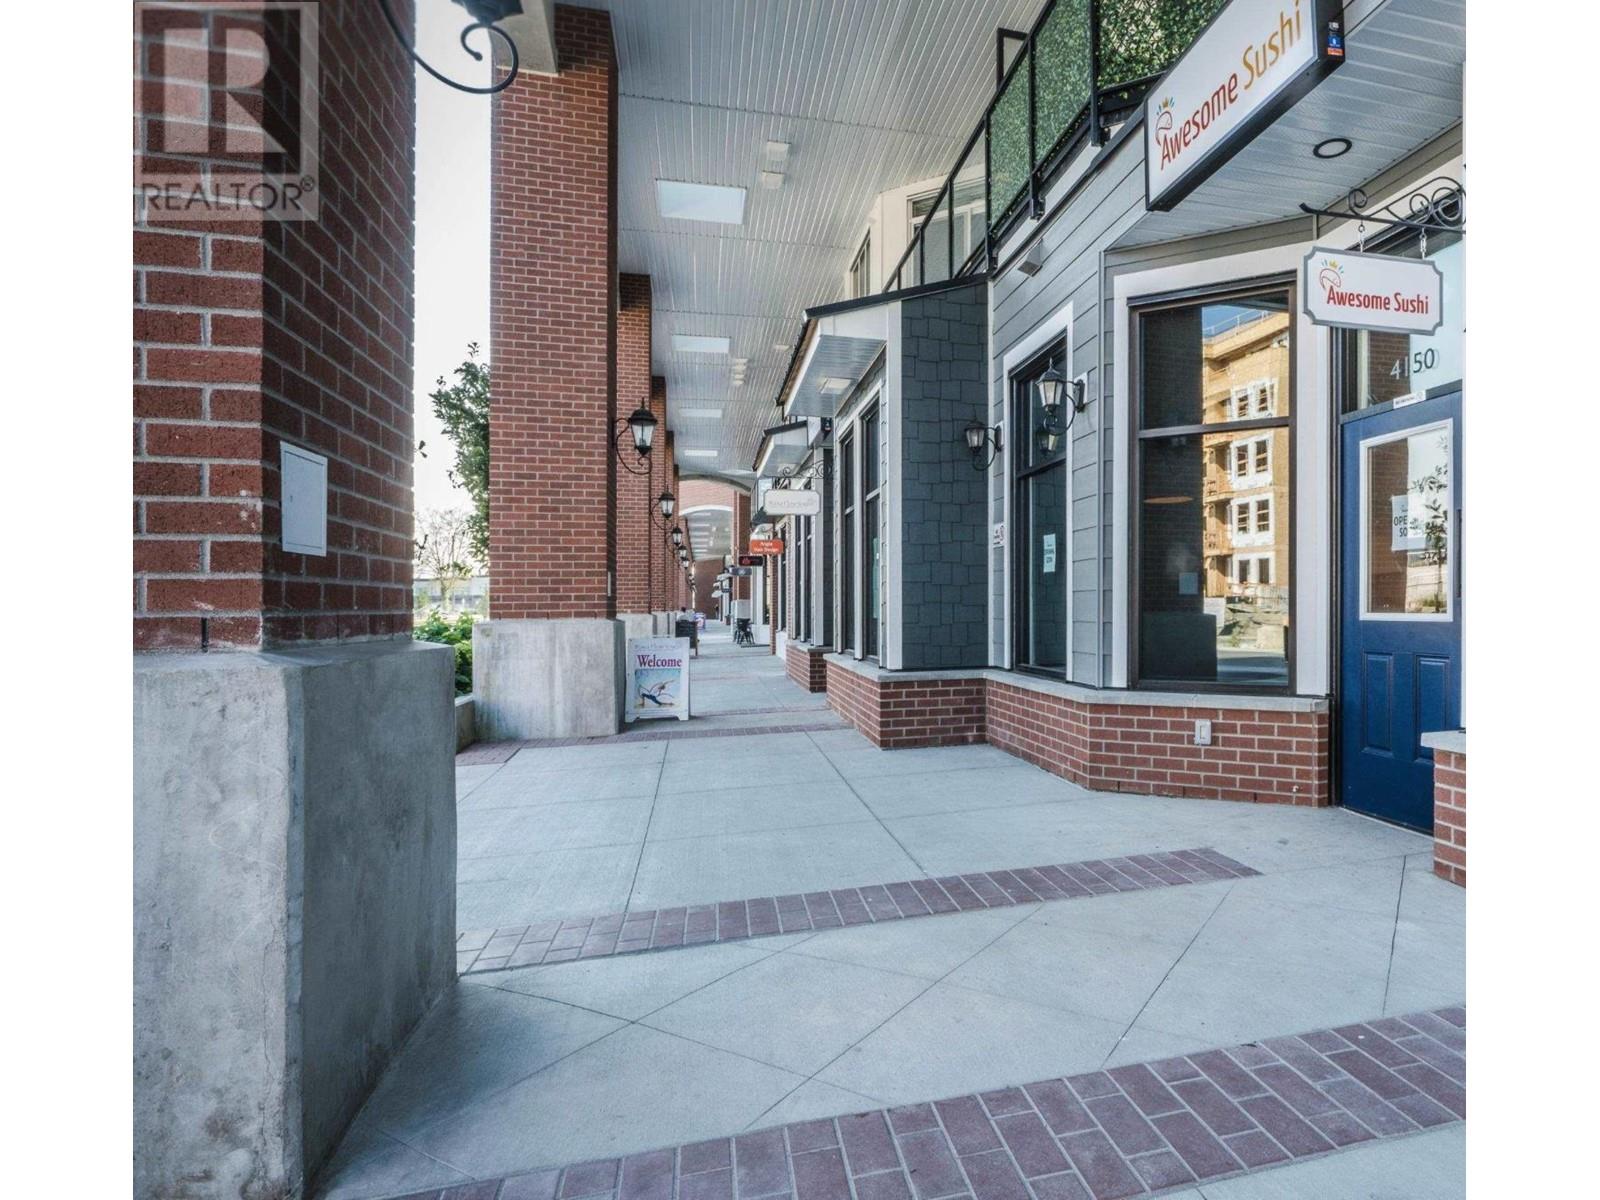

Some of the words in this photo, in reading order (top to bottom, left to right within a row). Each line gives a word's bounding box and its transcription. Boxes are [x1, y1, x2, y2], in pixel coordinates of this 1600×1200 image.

[1160, 73, 1239, 170] Awesome
[1243, 0, 1301, 90] Sushi
[1327, 286, 1390, 310] Awesome
[1394, 293, 1429, 314] Sushi
[1390, 348, 1435, 380] 4150
[637, 654, 683, 668] Welcome
